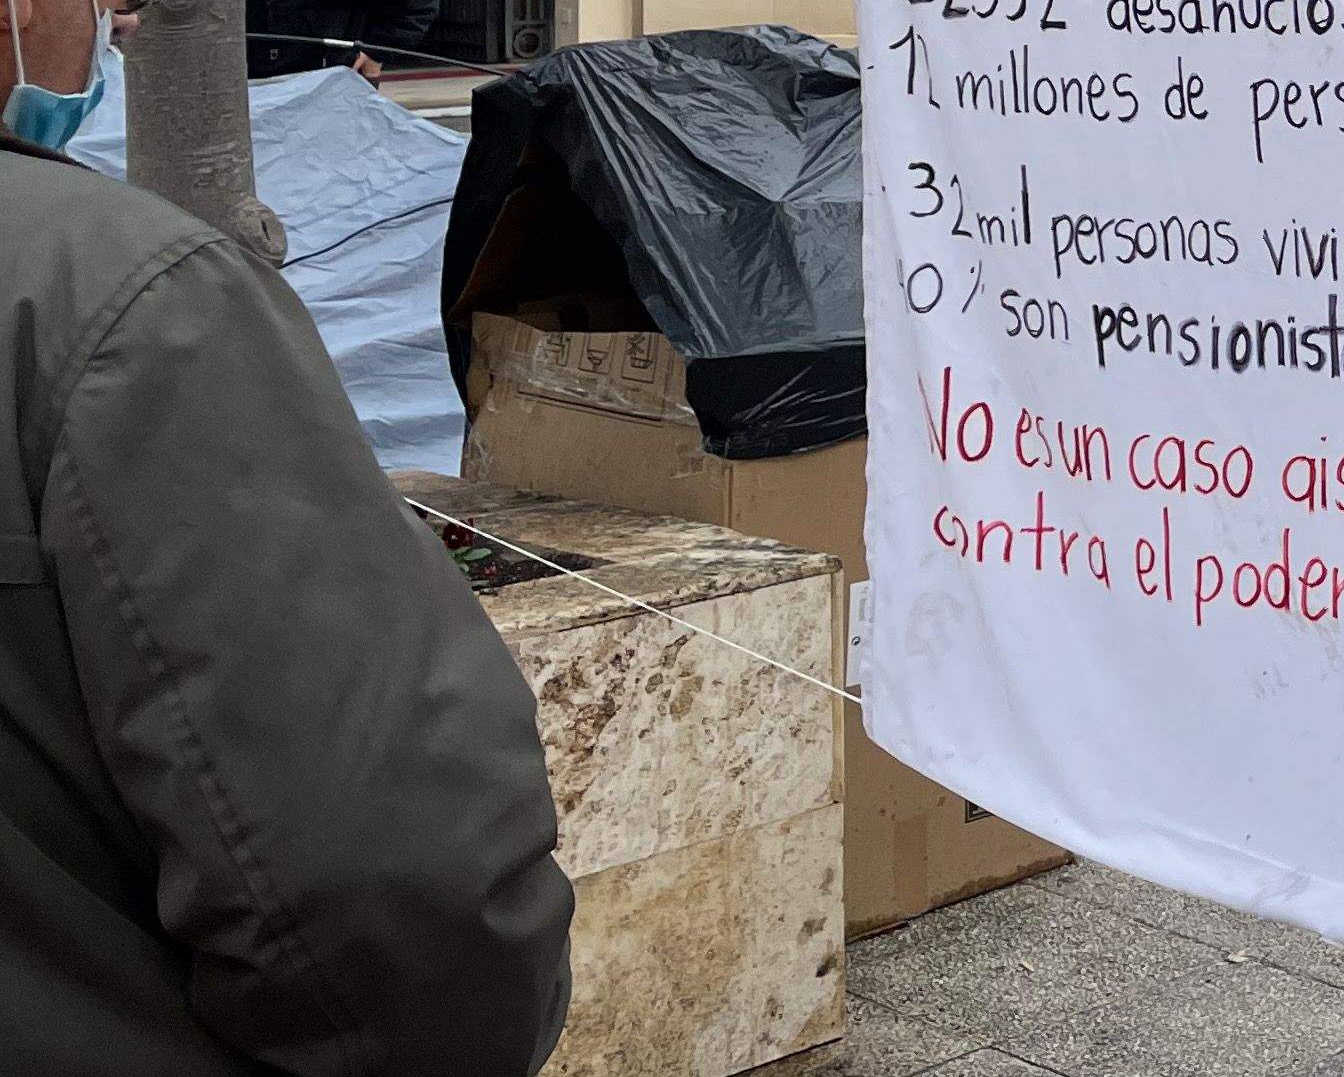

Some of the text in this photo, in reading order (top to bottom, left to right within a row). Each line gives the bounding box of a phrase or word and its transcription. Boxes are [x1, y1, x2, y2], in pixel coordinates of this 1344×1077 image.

[956, 44, 1140, 123] millones
[1164, 57, 1209, 121] de
[1051, 218, 1240, 278] personas
[1000, 287, 1071, 343] son
[1128, 428, 1255, 500] caso
[1134, 507, 1174, 601] el
